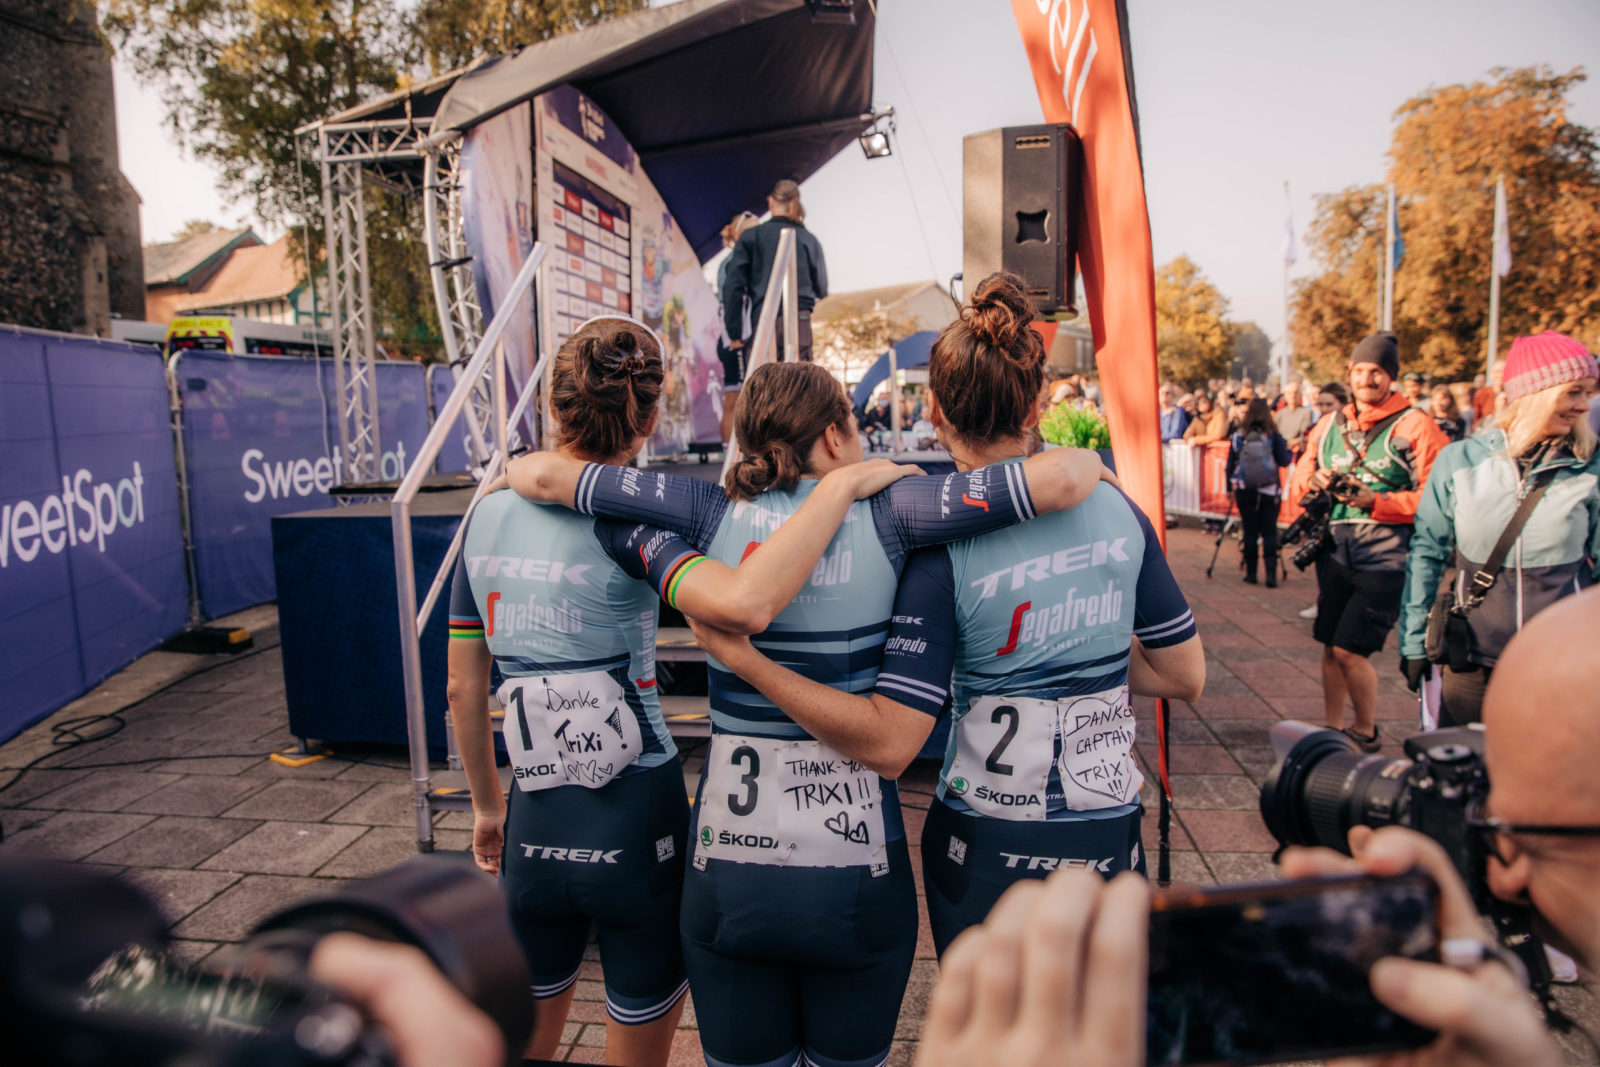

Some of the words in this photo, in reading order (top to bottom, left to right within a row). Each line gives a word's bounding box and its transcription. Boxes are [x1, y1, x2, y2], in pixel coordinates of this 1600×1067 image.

[468, 555, 596, 585] TREK
[970, 537, 1130, 600] TREK
[486, 591, 583, 638] Segafredo
[995, 577, 1124, 657] Segafredo
[510, 686, 534, 752] 1
[546, 688, 600, 713] Danke
[985, 705, 1020, 777] 2
[728, 745, 760, 816] 3
[974, 785, 1041, 806] ŠKODA
[520, 843, 624, 864] TREK
[1000, 852, 1115, 872] TREK
